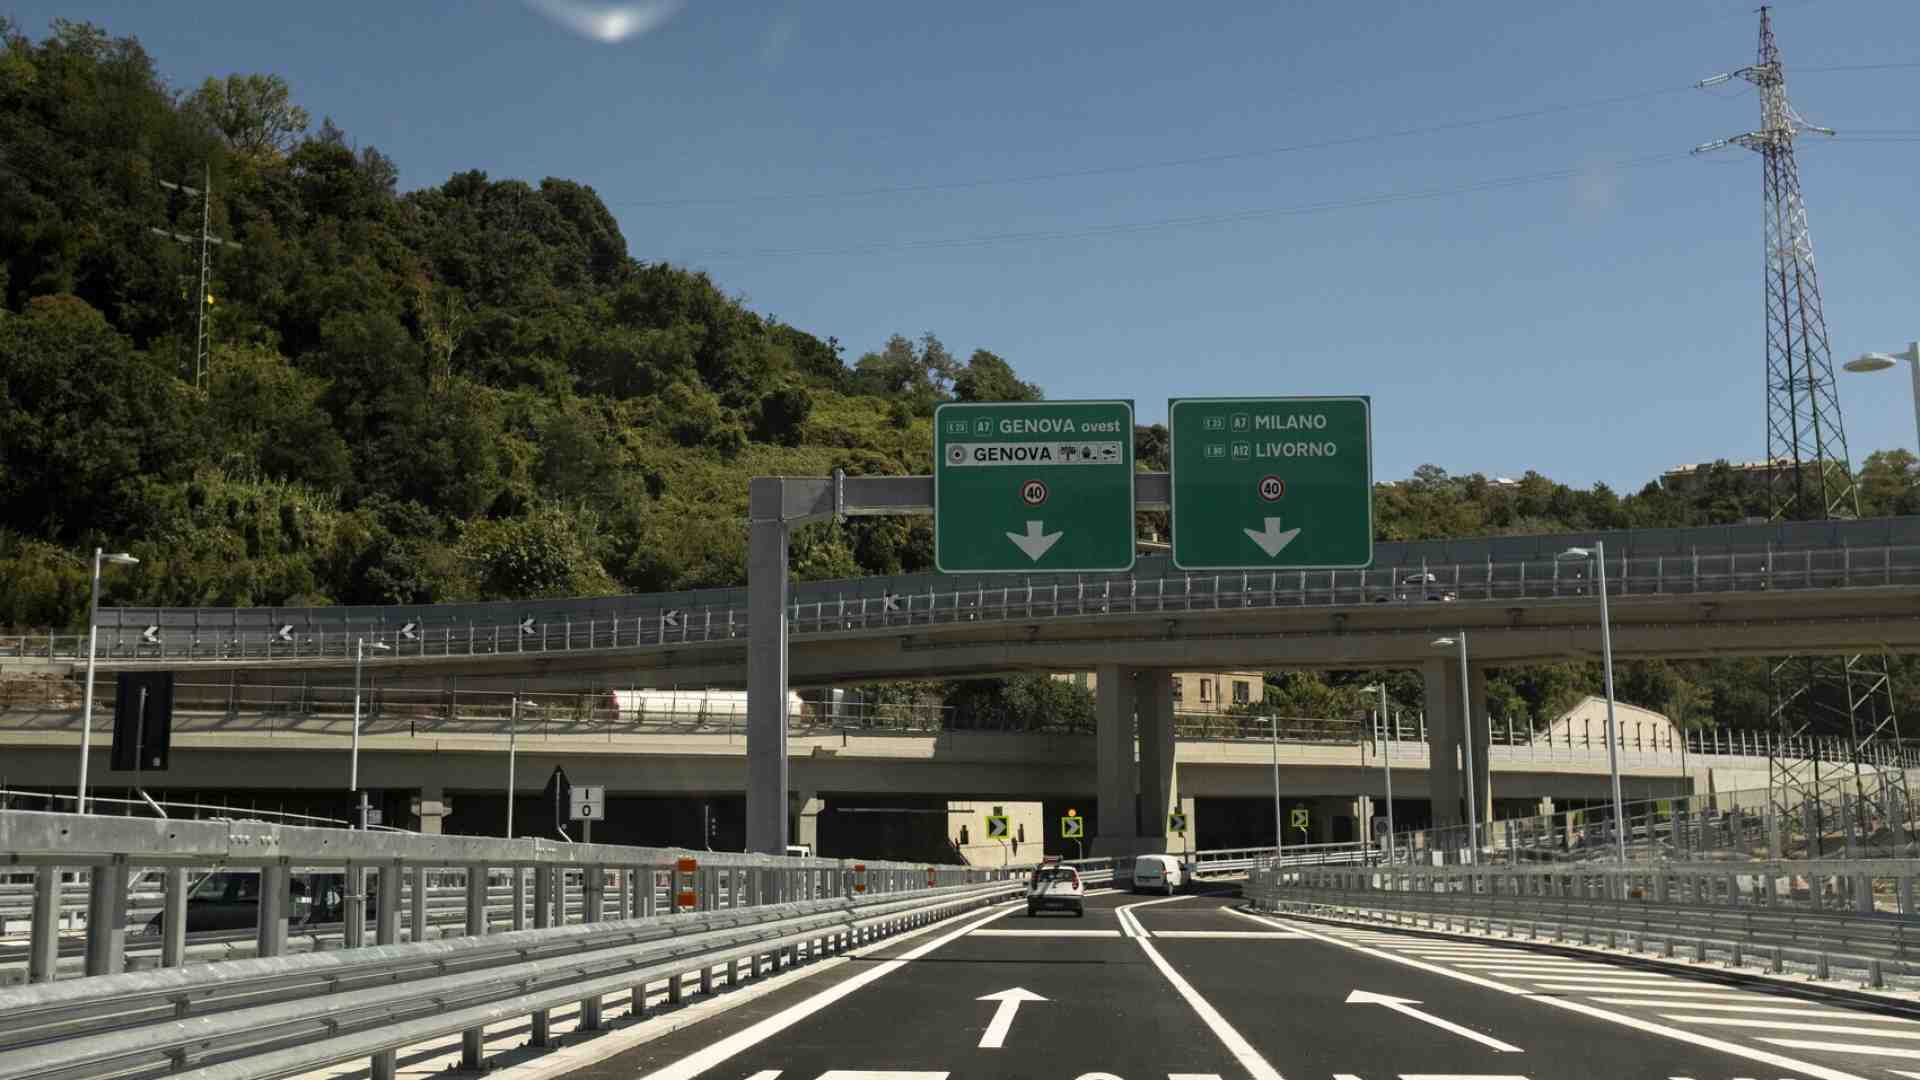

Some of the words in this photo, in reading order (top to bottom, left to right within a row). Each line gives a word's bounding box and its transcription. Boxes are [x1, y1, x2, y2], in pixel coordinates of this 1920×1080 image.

[977, 421, 991, 432] A7
[999, 418, 1075, 433] GENOVA
[1081, 420, 1121, 432] ovest
[1233, 417, 1247, 429] A7
[1255, 414, 1328, 429] MILANO
[973, 446, 1052, 462] GENOVA
[1256, 442, 1337, 457] LIVORNO
[1026, 486, 1042, 499] 40
[1263, 482, 1280, 495] 40
